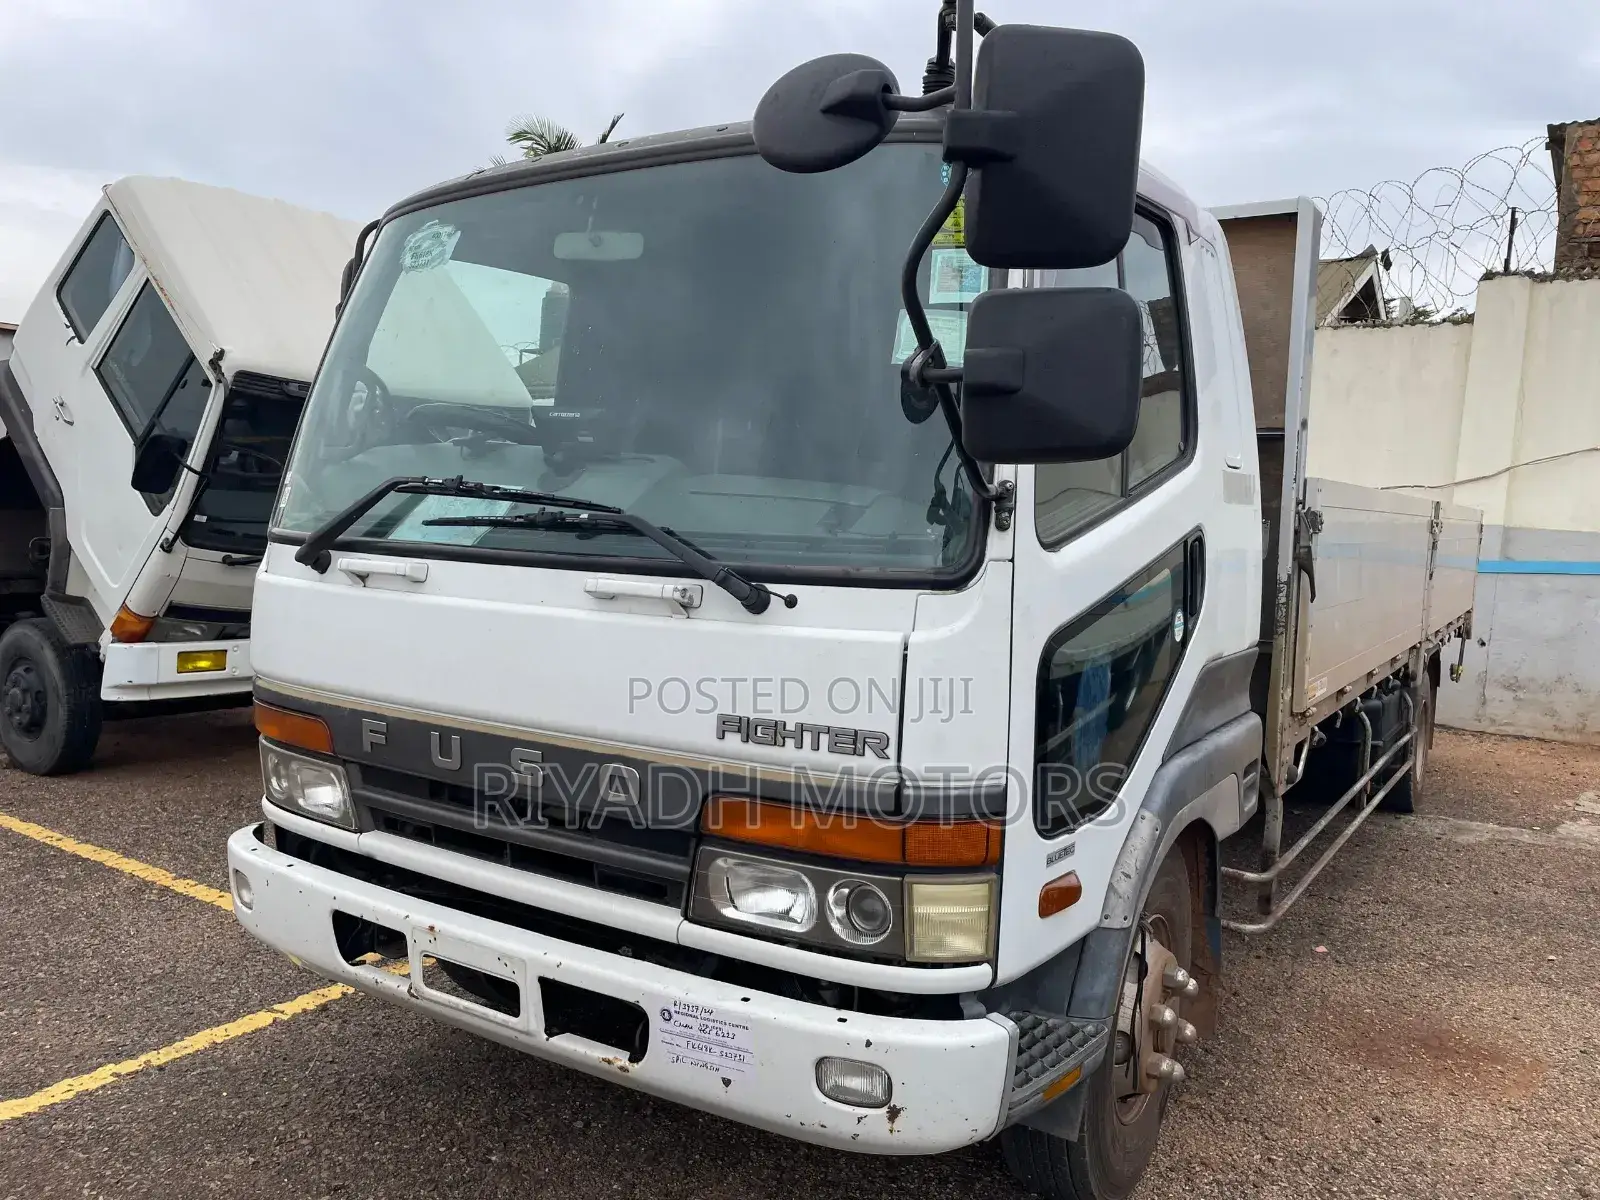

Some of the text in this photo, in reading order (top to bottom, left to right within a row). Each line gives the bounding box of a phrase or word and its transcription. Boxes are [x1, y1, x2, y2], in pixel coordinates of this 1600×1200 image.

[716, 713, 891, 760] FIGHTER
[362, 718, 641, 807] FUSO
[674, 1010, 749, 1031] REGIONAL LOGISTICS CENTRE
